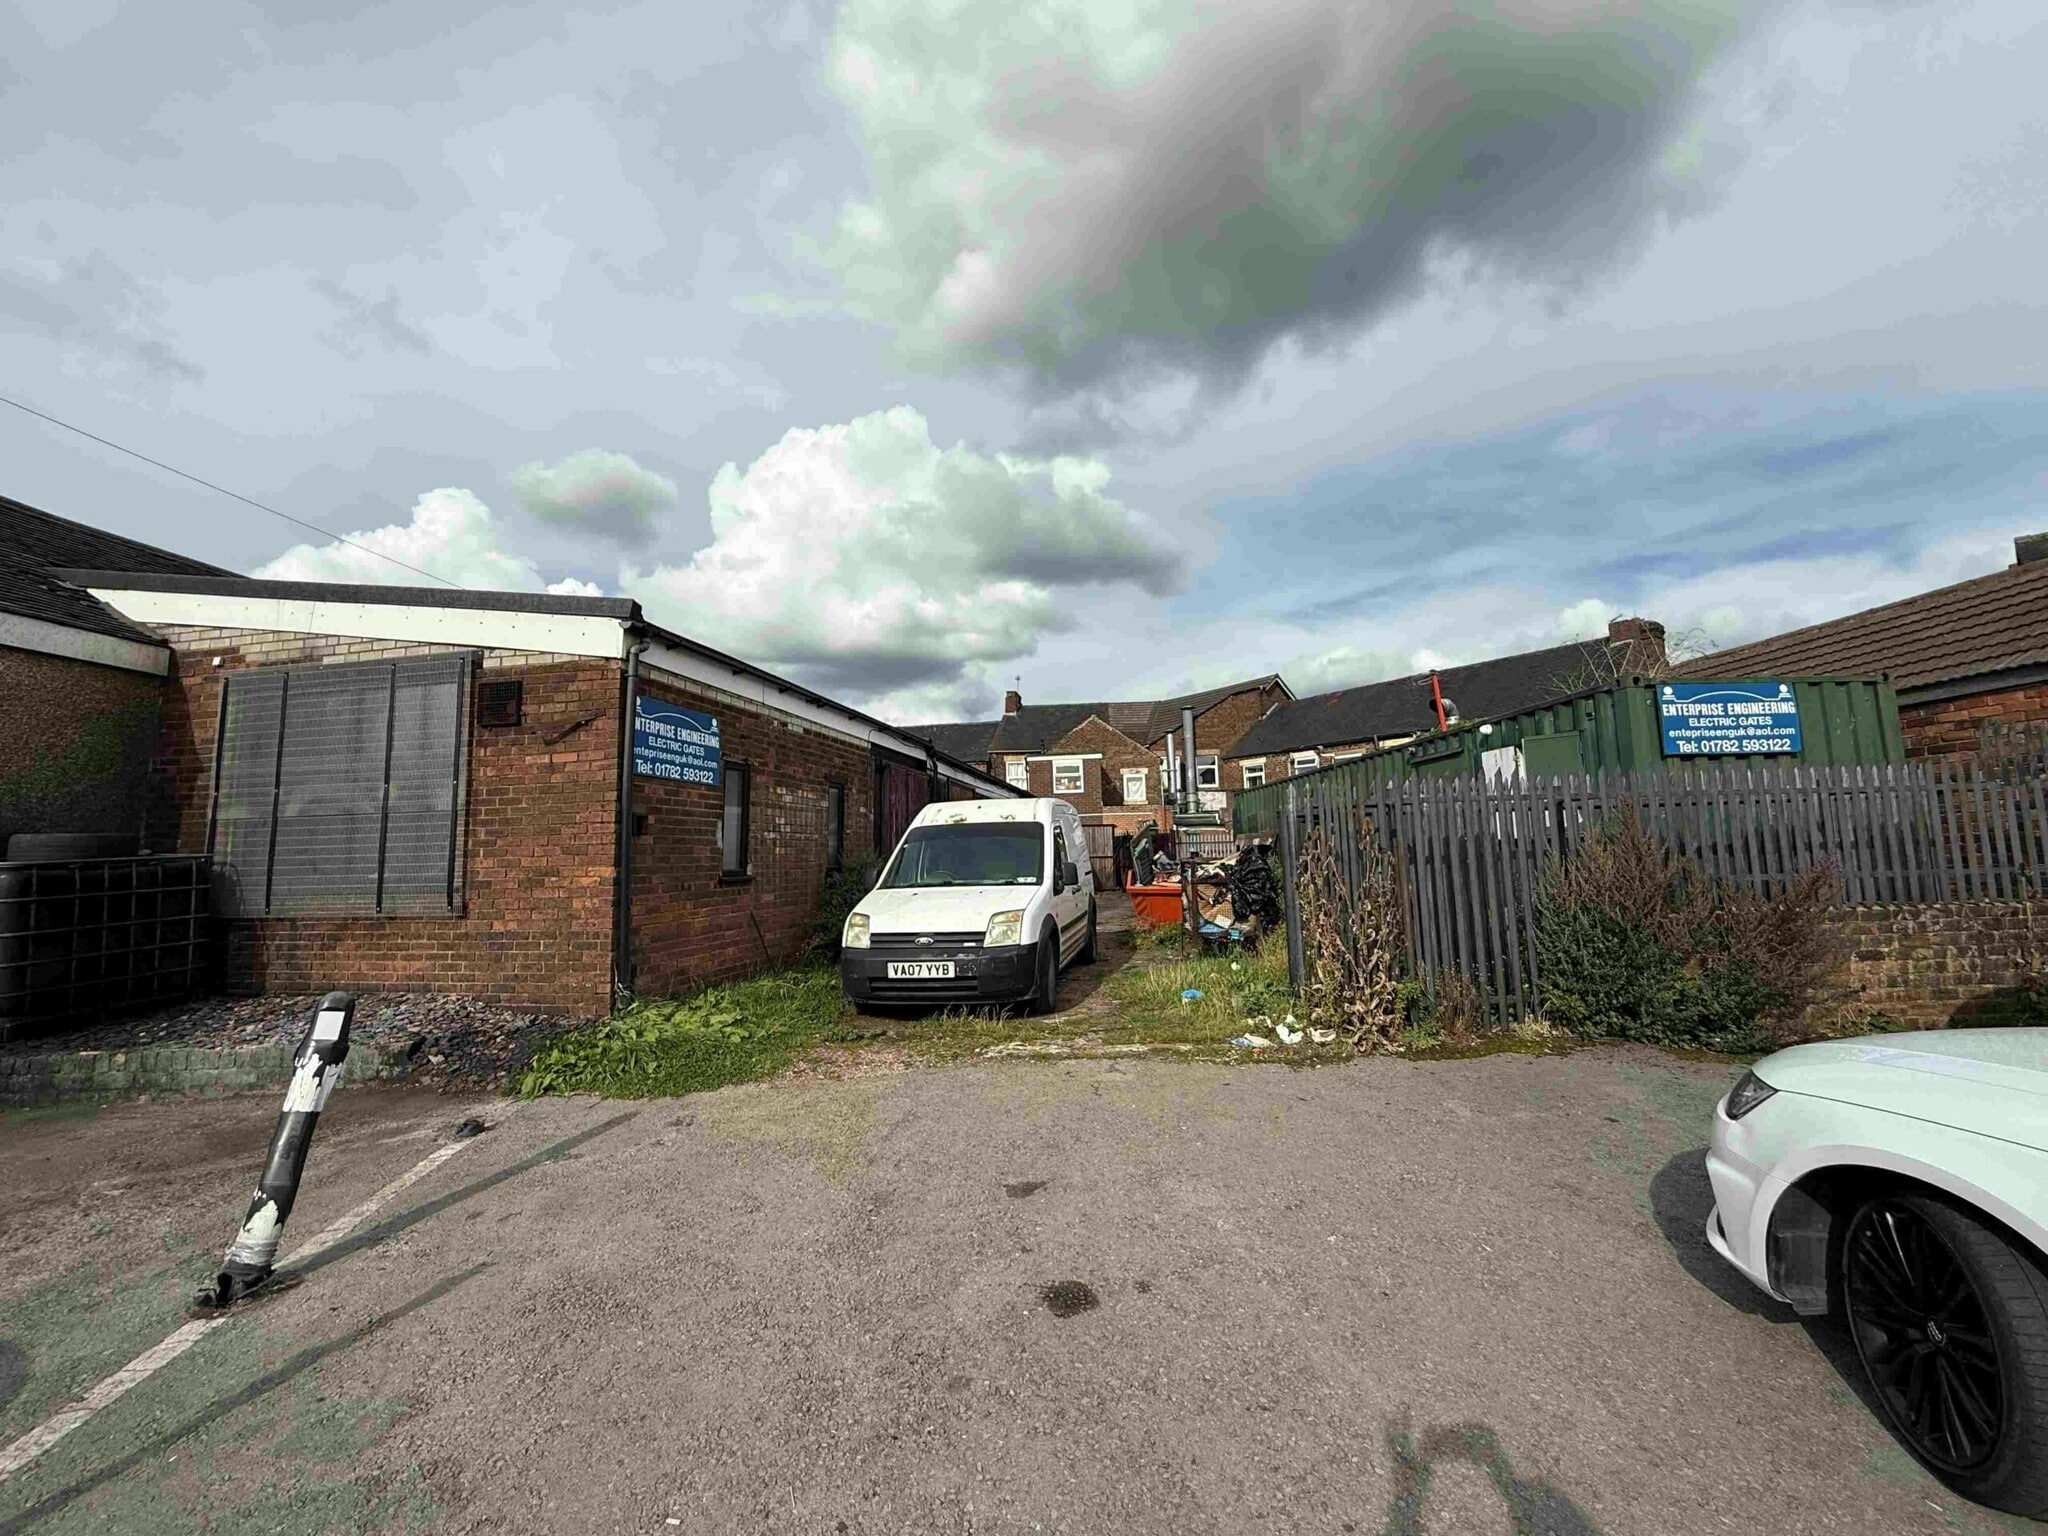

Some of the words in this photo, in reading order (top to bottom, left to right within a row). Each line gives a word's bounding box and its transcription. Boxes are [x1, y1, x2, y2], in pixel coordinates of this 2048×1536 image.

[1662, 703, 1725, 716] ENTERPRISE
[1727, 701, 1796, 715] ENGINEERING
[1688, 717, 1737, 727] ELECTRIC
[1738, 716, 1773, 726] GATES
[635, 716, 676, 738] NTERPRISE
[677, 727, 720, 748] ENGINEERING
[1668, 727, 1796, 738] entepriseenguk@aol.com
[648, 736, 682, 752] ELECTRIC
[683, 743, 705, 756] GATES
[1676, 740, 1699, 753] Tel:
[1701, 739, 1740, 752] 01782
[1742, 738, 1792, 752] 593122
[635, 759, 653, 775] Tel:
[654, 762, 681, 779] 01782
[682, 767, 714, 784] 593122
[892, 964, 922, 976] VA07
[926, 964, 950, 976] YYB
